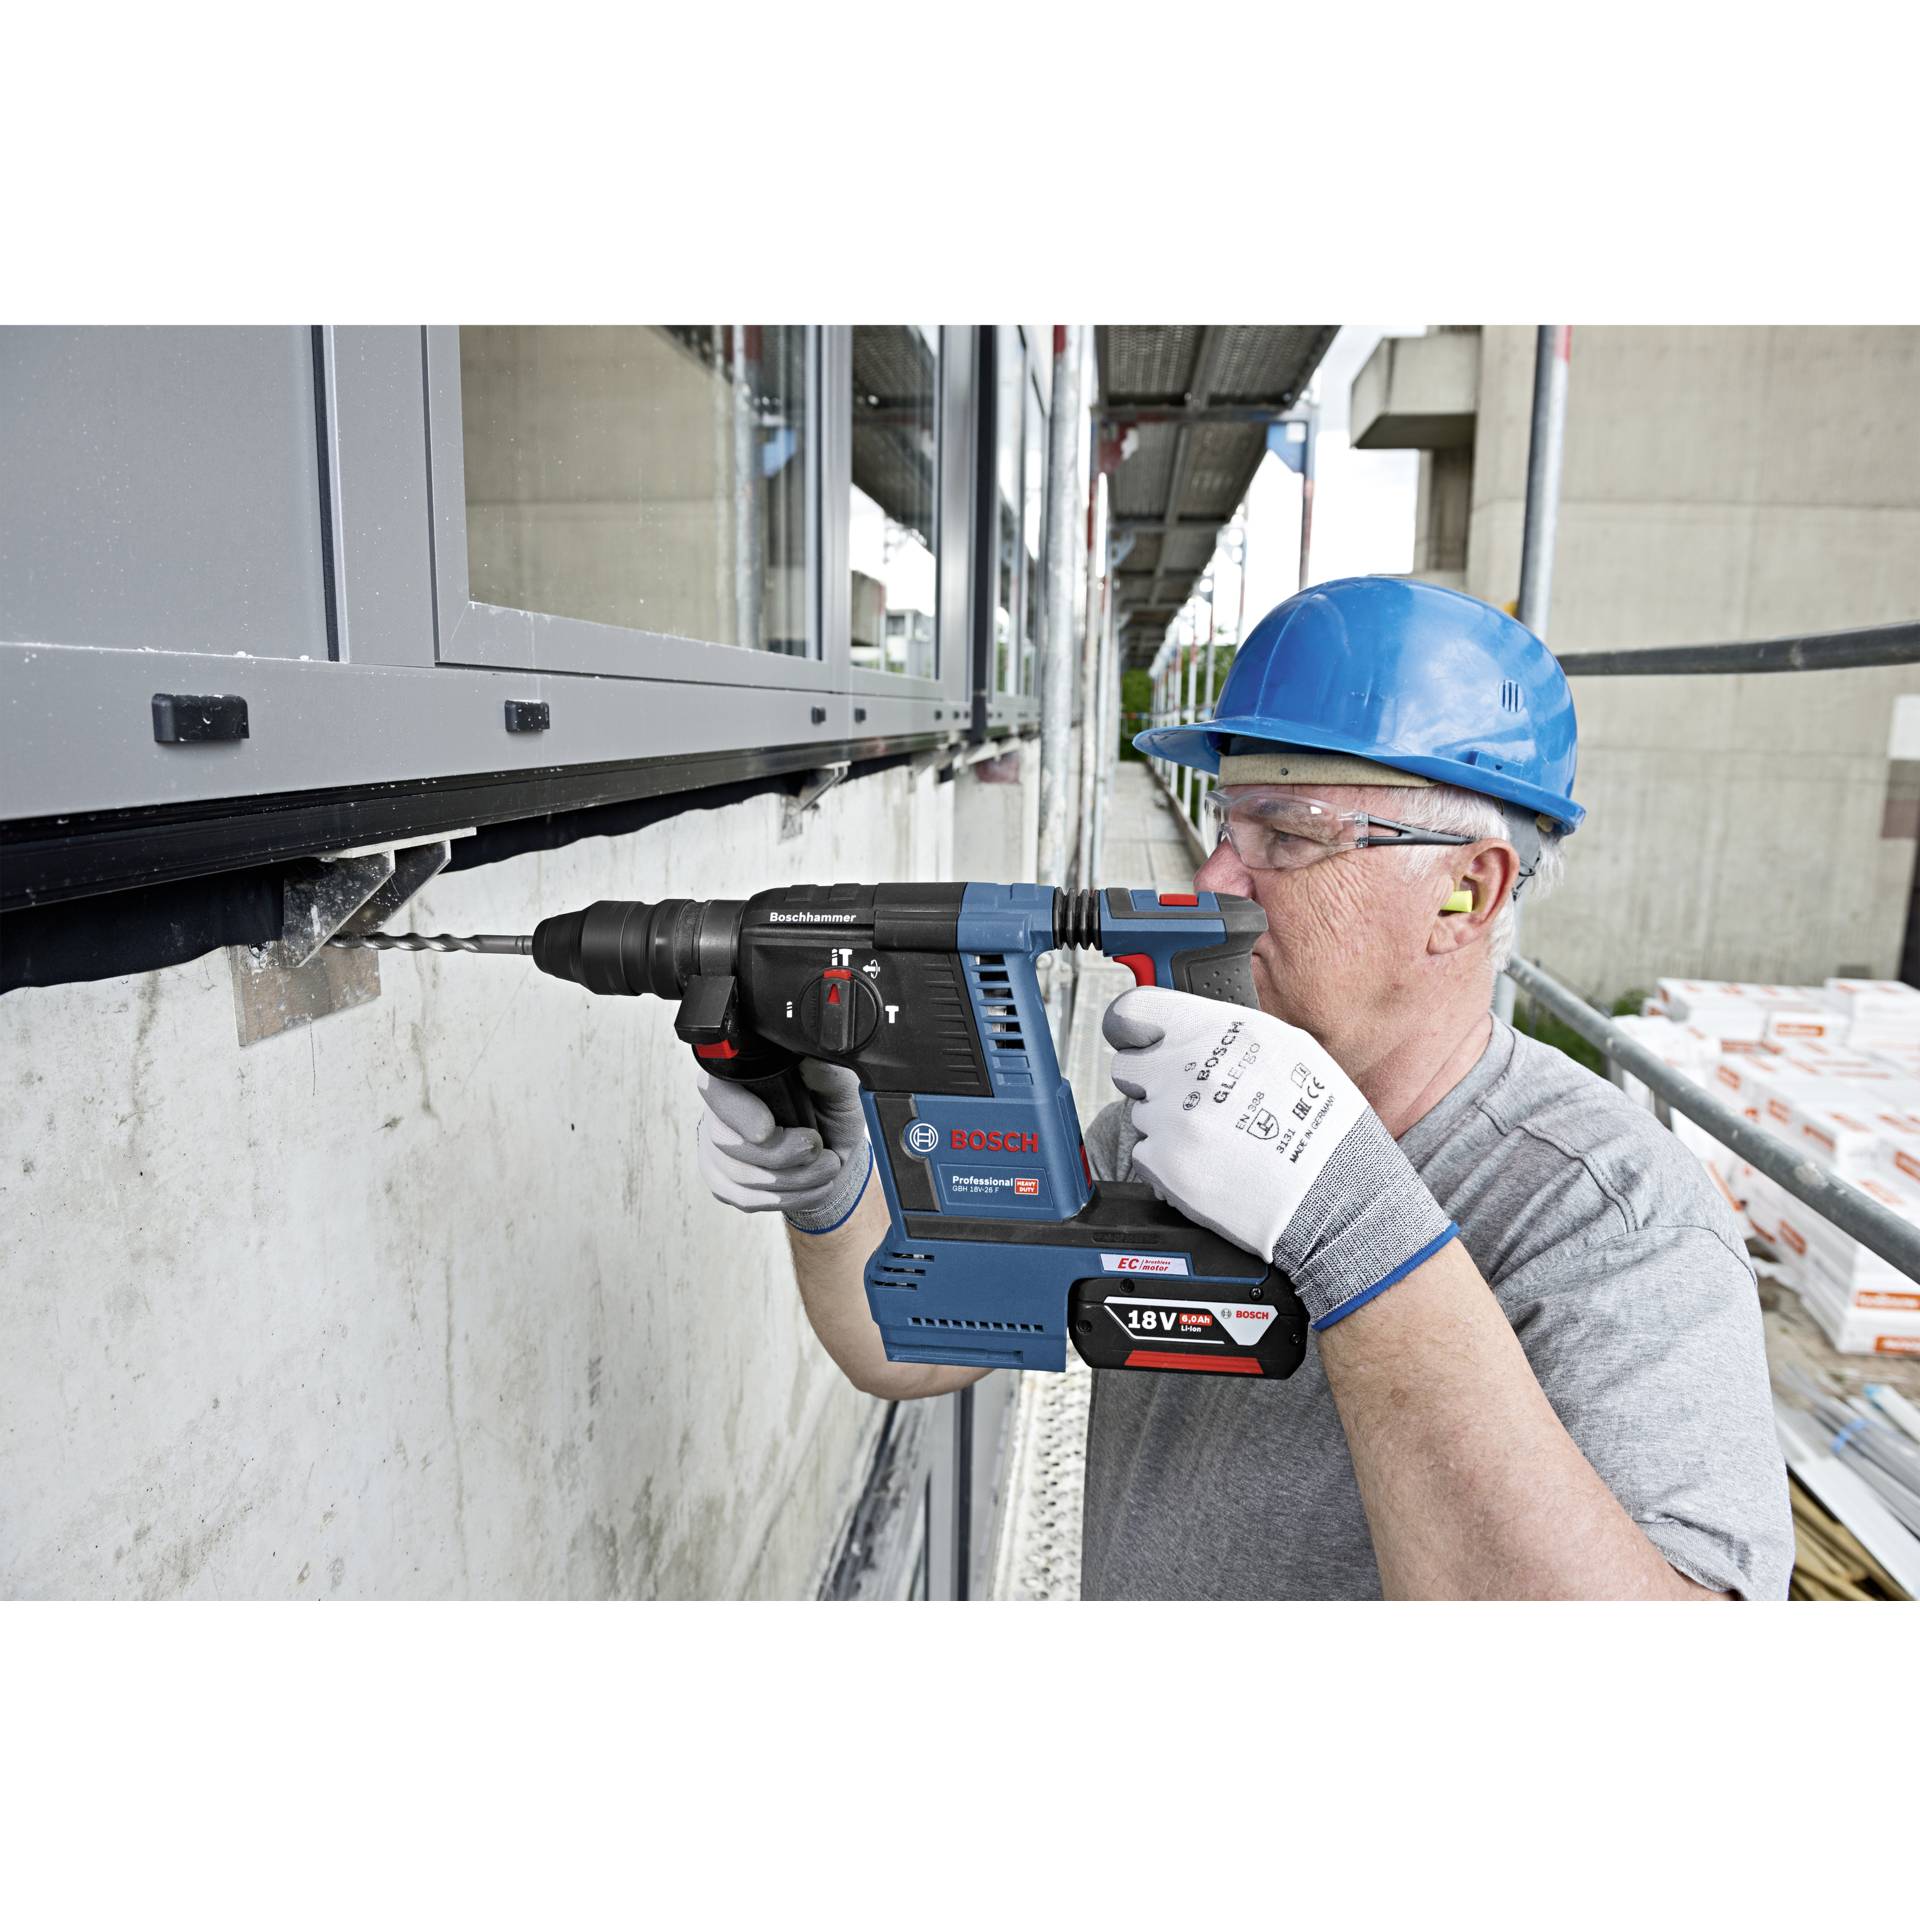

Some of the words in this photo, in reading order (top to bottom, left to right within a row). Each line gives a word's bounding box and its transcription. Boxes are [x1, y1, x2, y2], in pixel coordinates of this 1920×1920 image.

[769, 912, 856, 922] Boschhammer
[1197, 1021, 1244, 1081] BOSCH
[1235, 1114, 1250, 1130] EN
[1289, 1140, 1307, 1163] MADE
[1305, 1130, 1313, 1140] IN
[1311, 1095, 1336, 1130] GERMANY
[950, 1129, 1038, 1152] BOSCH
[1276, 1128, 1296, 1154] 3131
[952, 1176, 1013, 1187] Professional
[952, 1185, 968, 1193] GBH
[970, 1186, 993, 1194] 18V-26
[1117, 1257, 1139, 1270] EC
[1142, 1264, 1169, 1272] motor
[1128, 1309, 1178, 1331] 18V
[1235, 1310, 1269, 1320] BOSCH
[1181, 1325, 1202, 1333] Li-Ion
